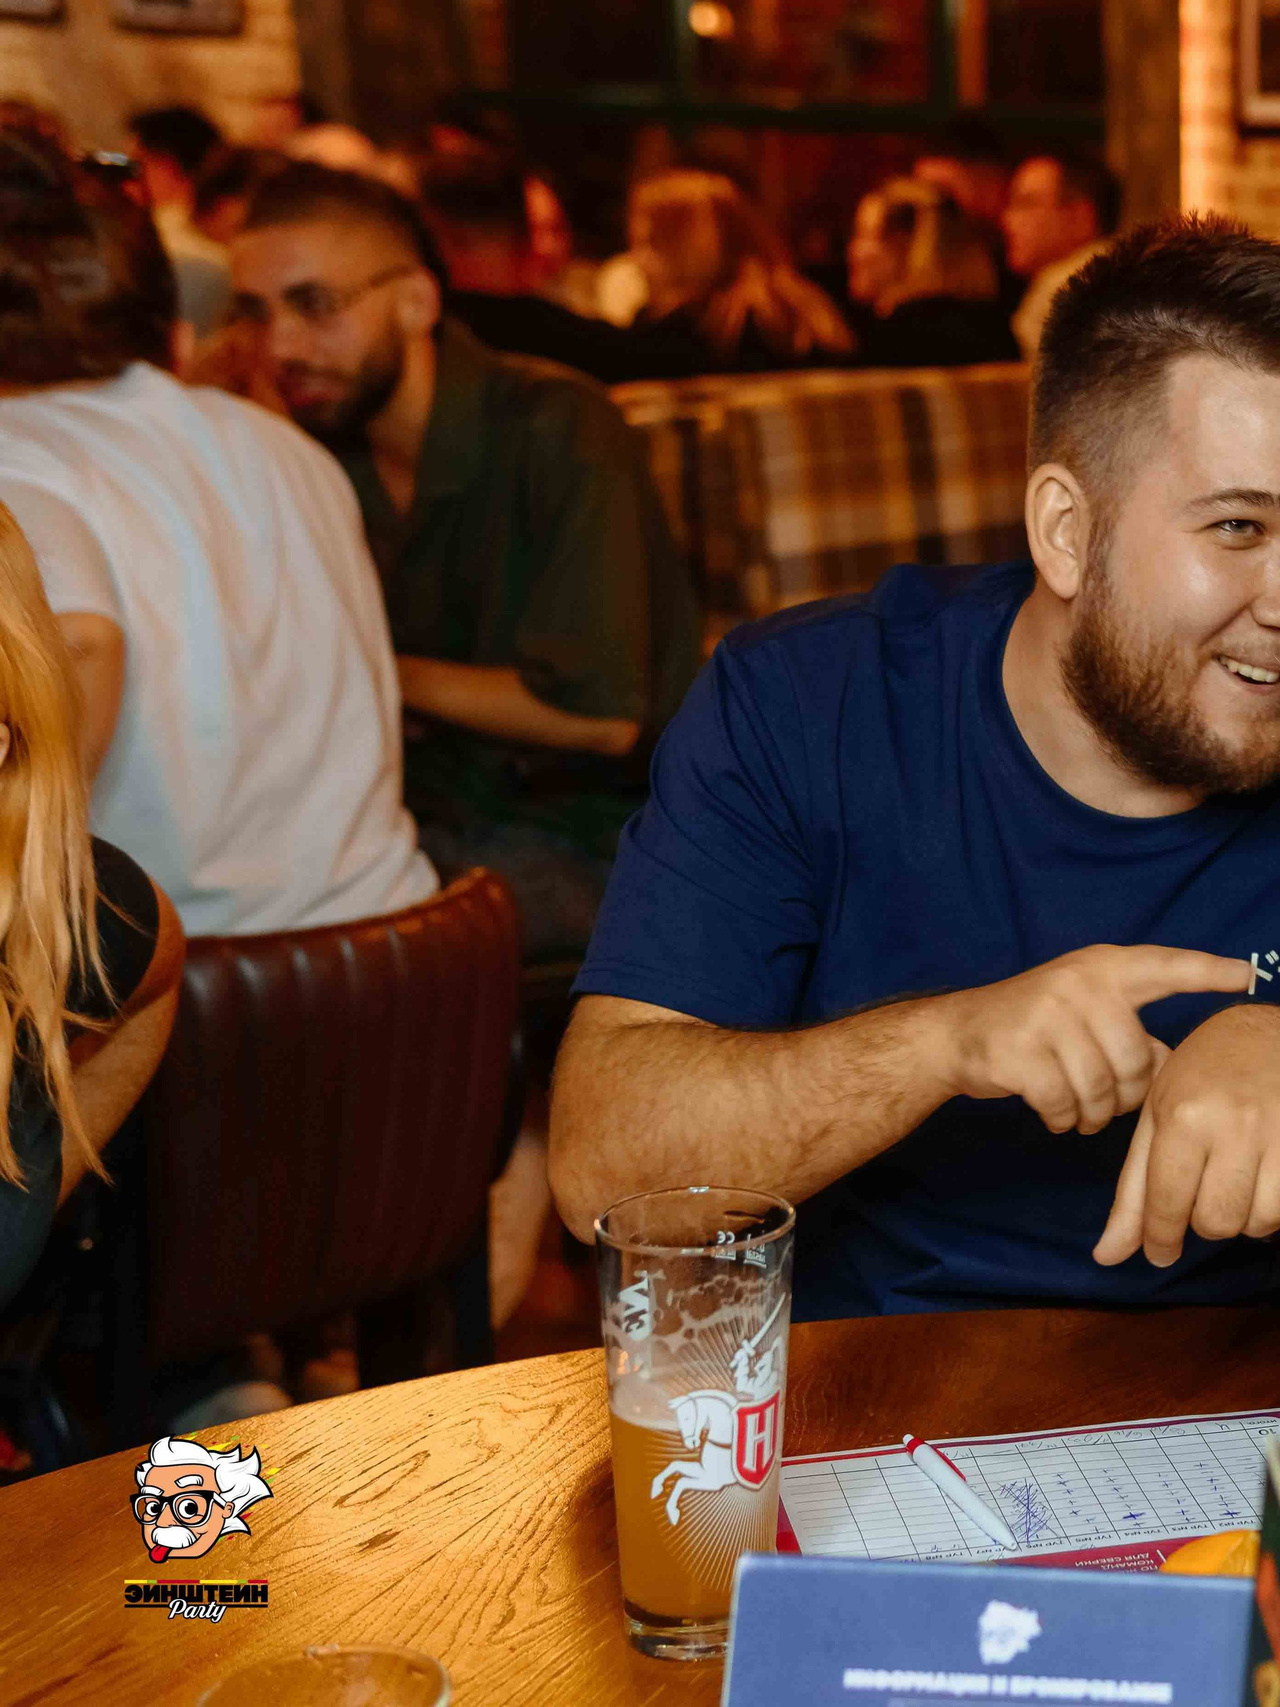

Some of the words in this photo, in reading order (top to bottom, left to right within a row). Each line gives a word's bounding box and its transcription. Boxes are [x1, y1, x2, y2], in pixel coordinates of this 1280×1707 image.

[1258, 1428, 1277, 1437] 10
[743, 1406, 775, 1474] H
[1074, 1554, 1130, 1567] СВЕРКИ
[1132, 1552, 1150, 1561] ДЛЯ
